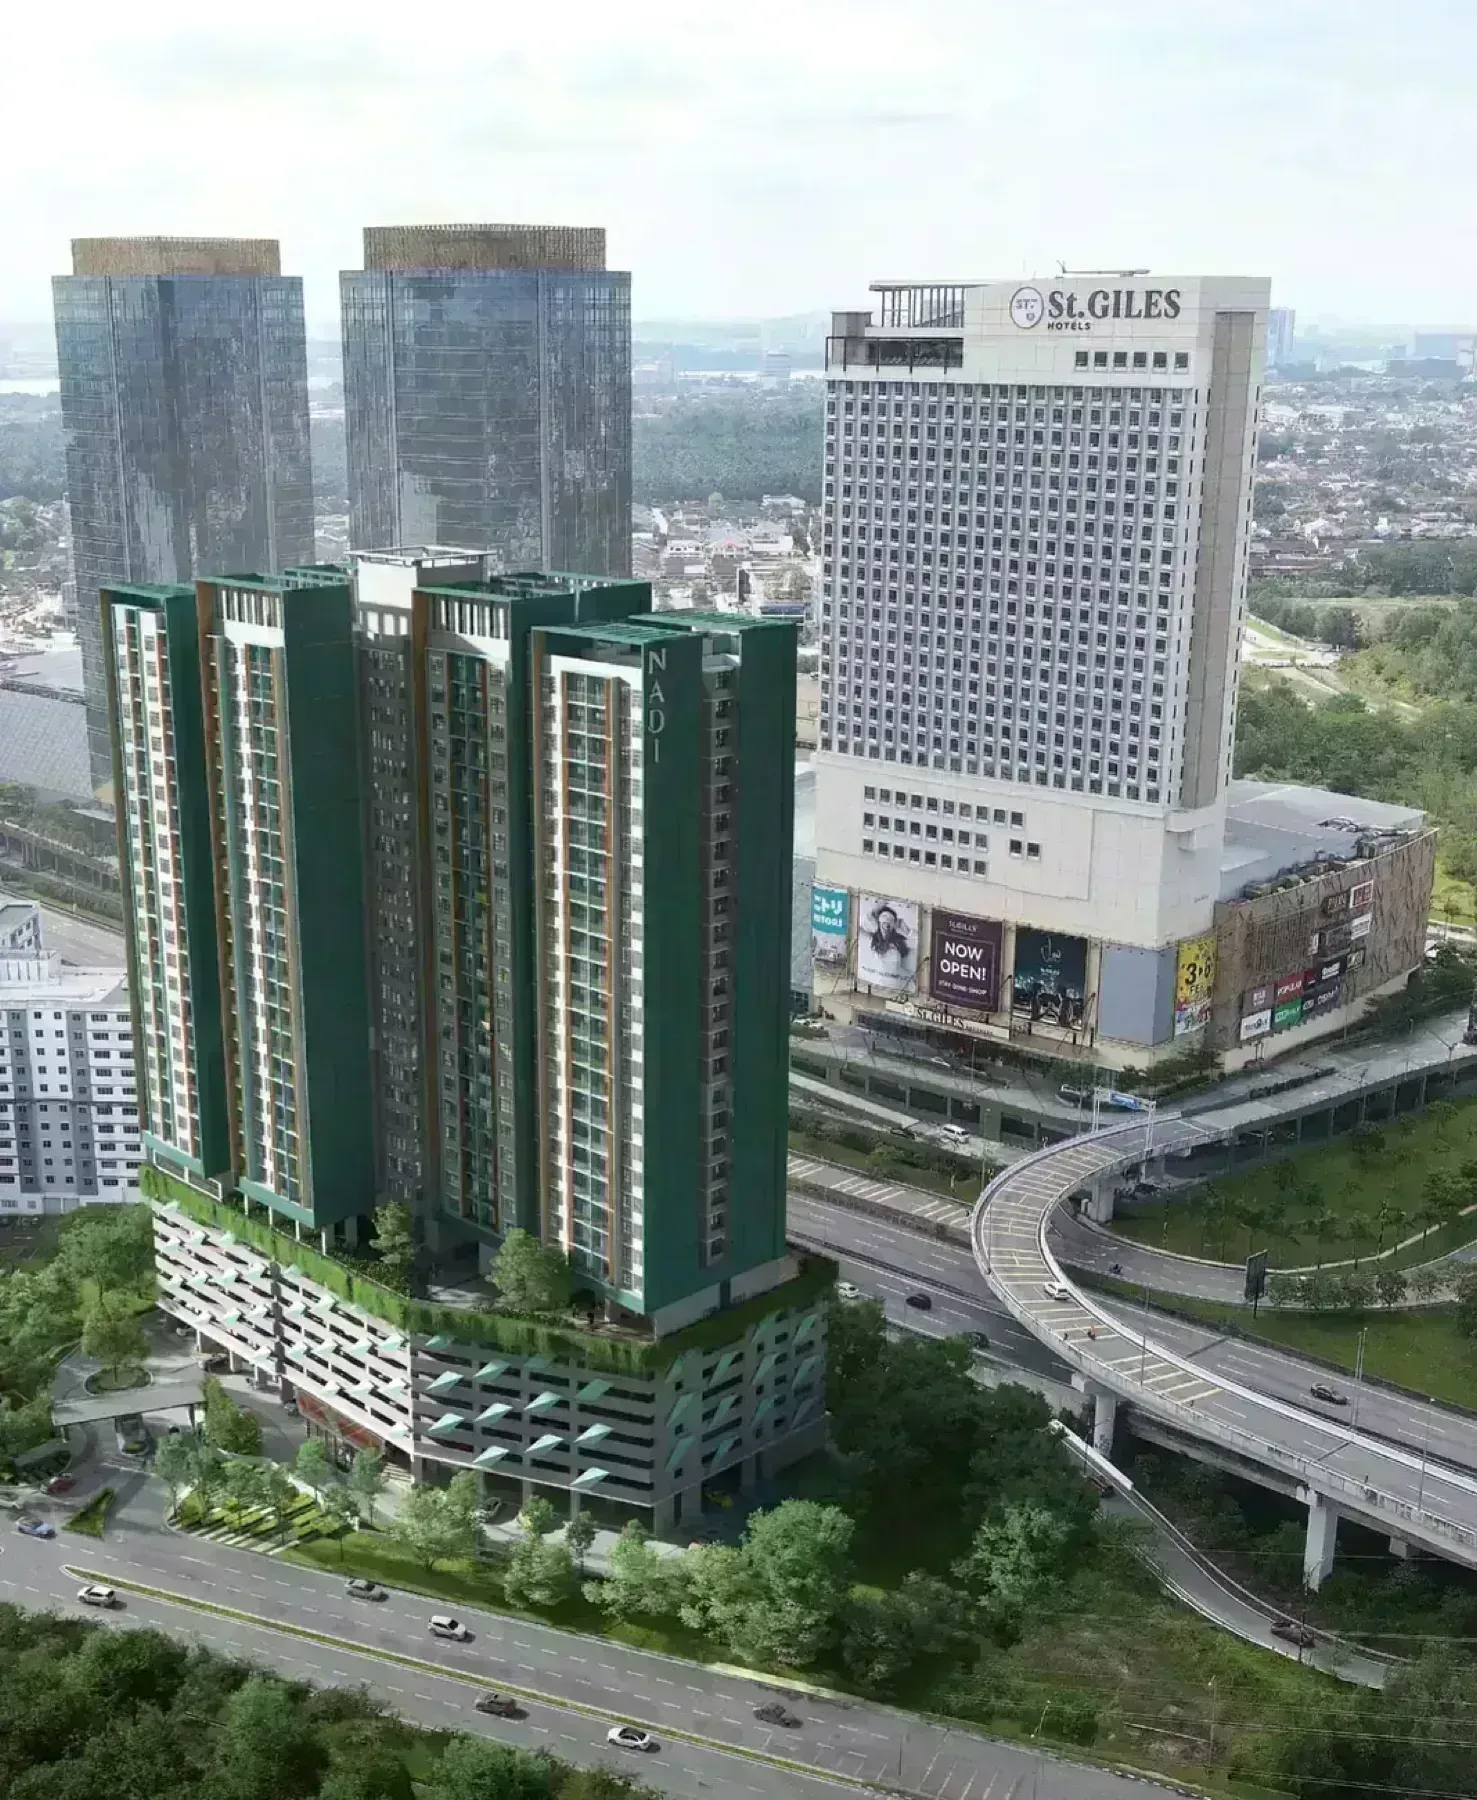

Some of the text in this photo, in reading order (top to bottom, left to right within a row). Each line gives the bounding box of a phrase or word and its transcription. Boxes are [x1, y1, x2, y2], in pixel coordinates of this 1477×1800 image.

[1047, 322, 1091, 331] HOTELS
[648, 648, 667, 763] NADI
[813, 895, 843, 915] ニトリ
[944, 941, 984, 962] NOW
[940, 959, 987, 981] OPEN!
